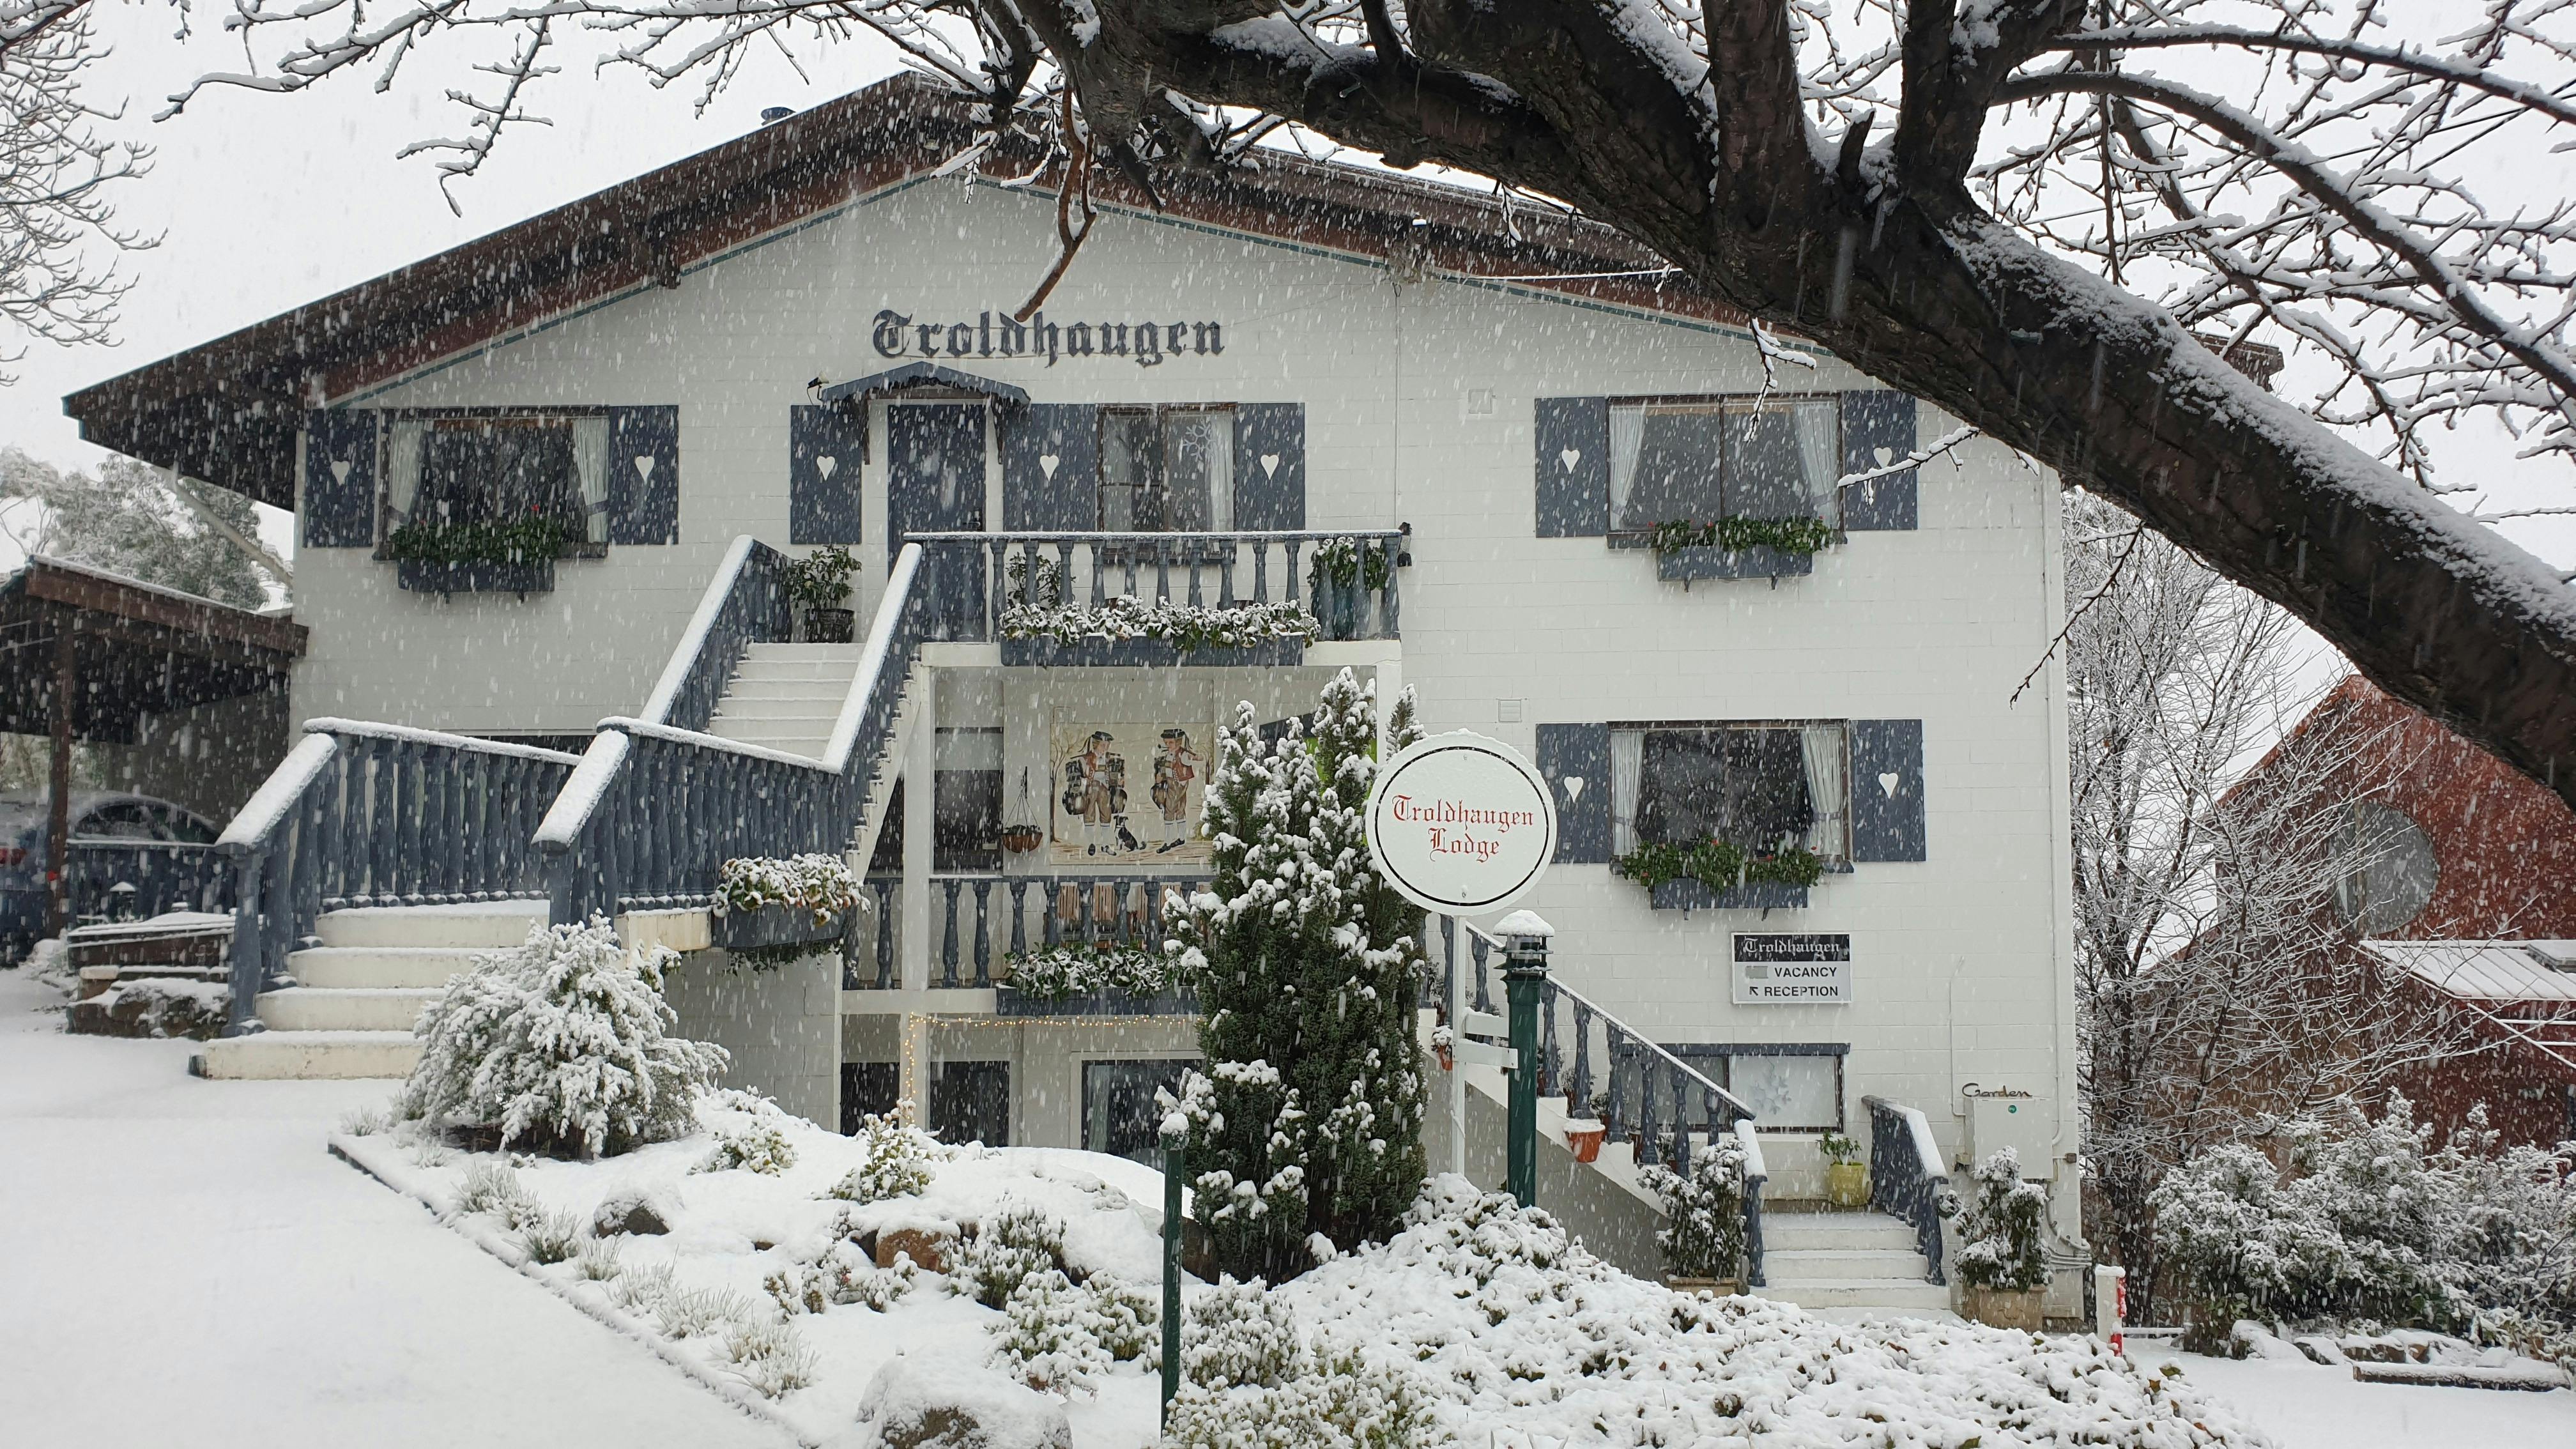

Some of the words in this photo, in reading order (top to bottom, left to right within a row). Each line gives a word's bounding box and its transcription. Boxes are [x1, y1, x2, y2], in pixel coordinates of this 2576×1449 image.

[872, 309, 1225, 369] Troldhaugen
[1392, 795, 1534, 833] Troldhaugen
[1427, 827, 1500, 863] Lodge
[1744, 937, 1840, 960] Troldhaugen
[1774, 967, 1837, 977] VACANCY
[1764, 986, 1839, 997] RECEPTION
[1961, 1082, 2033, 1098] Garden
